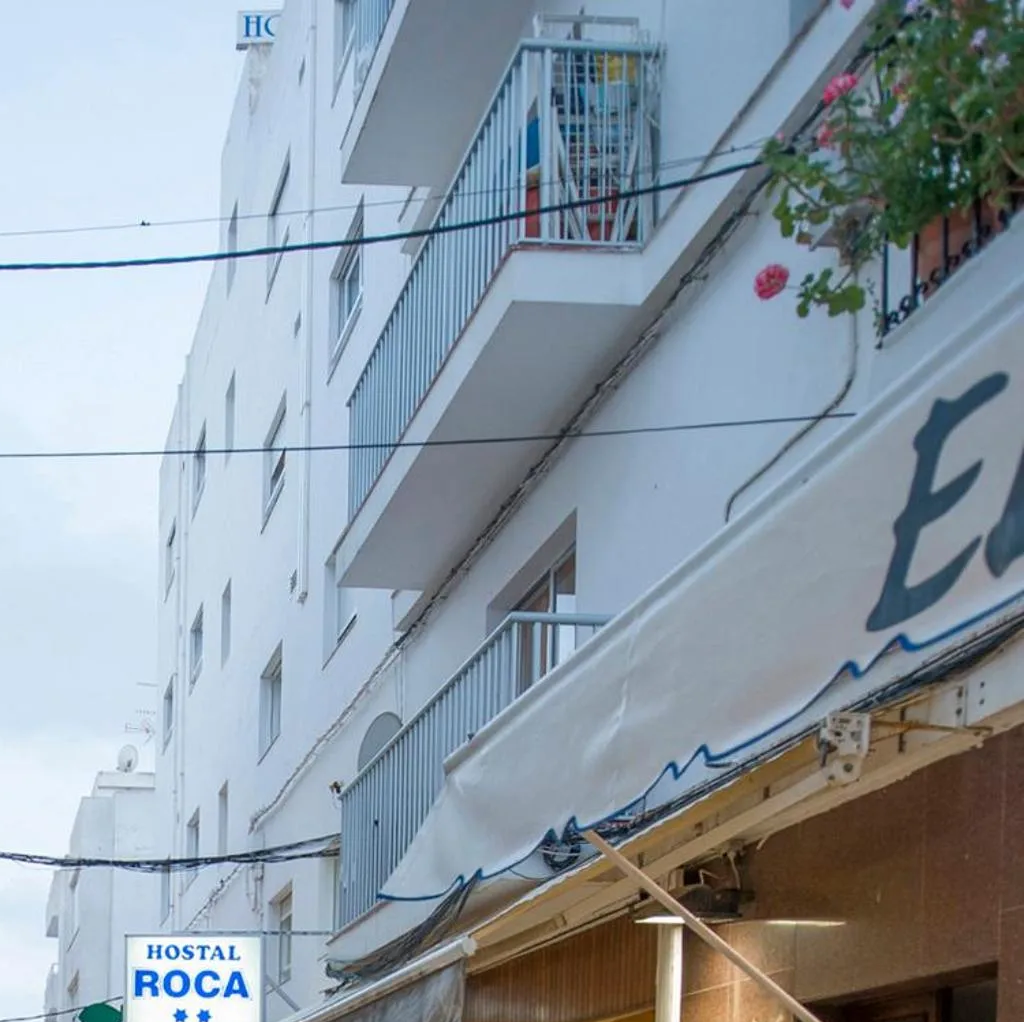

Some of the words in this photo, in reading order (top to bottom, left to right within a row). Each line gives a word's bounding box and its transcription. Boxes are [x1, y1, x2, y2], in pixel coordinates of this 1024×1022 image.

[866, 371, 1024, 632] E
[146, 944, 241, 961] HOSTAL
[134, 969, 249, 998] ROCA
